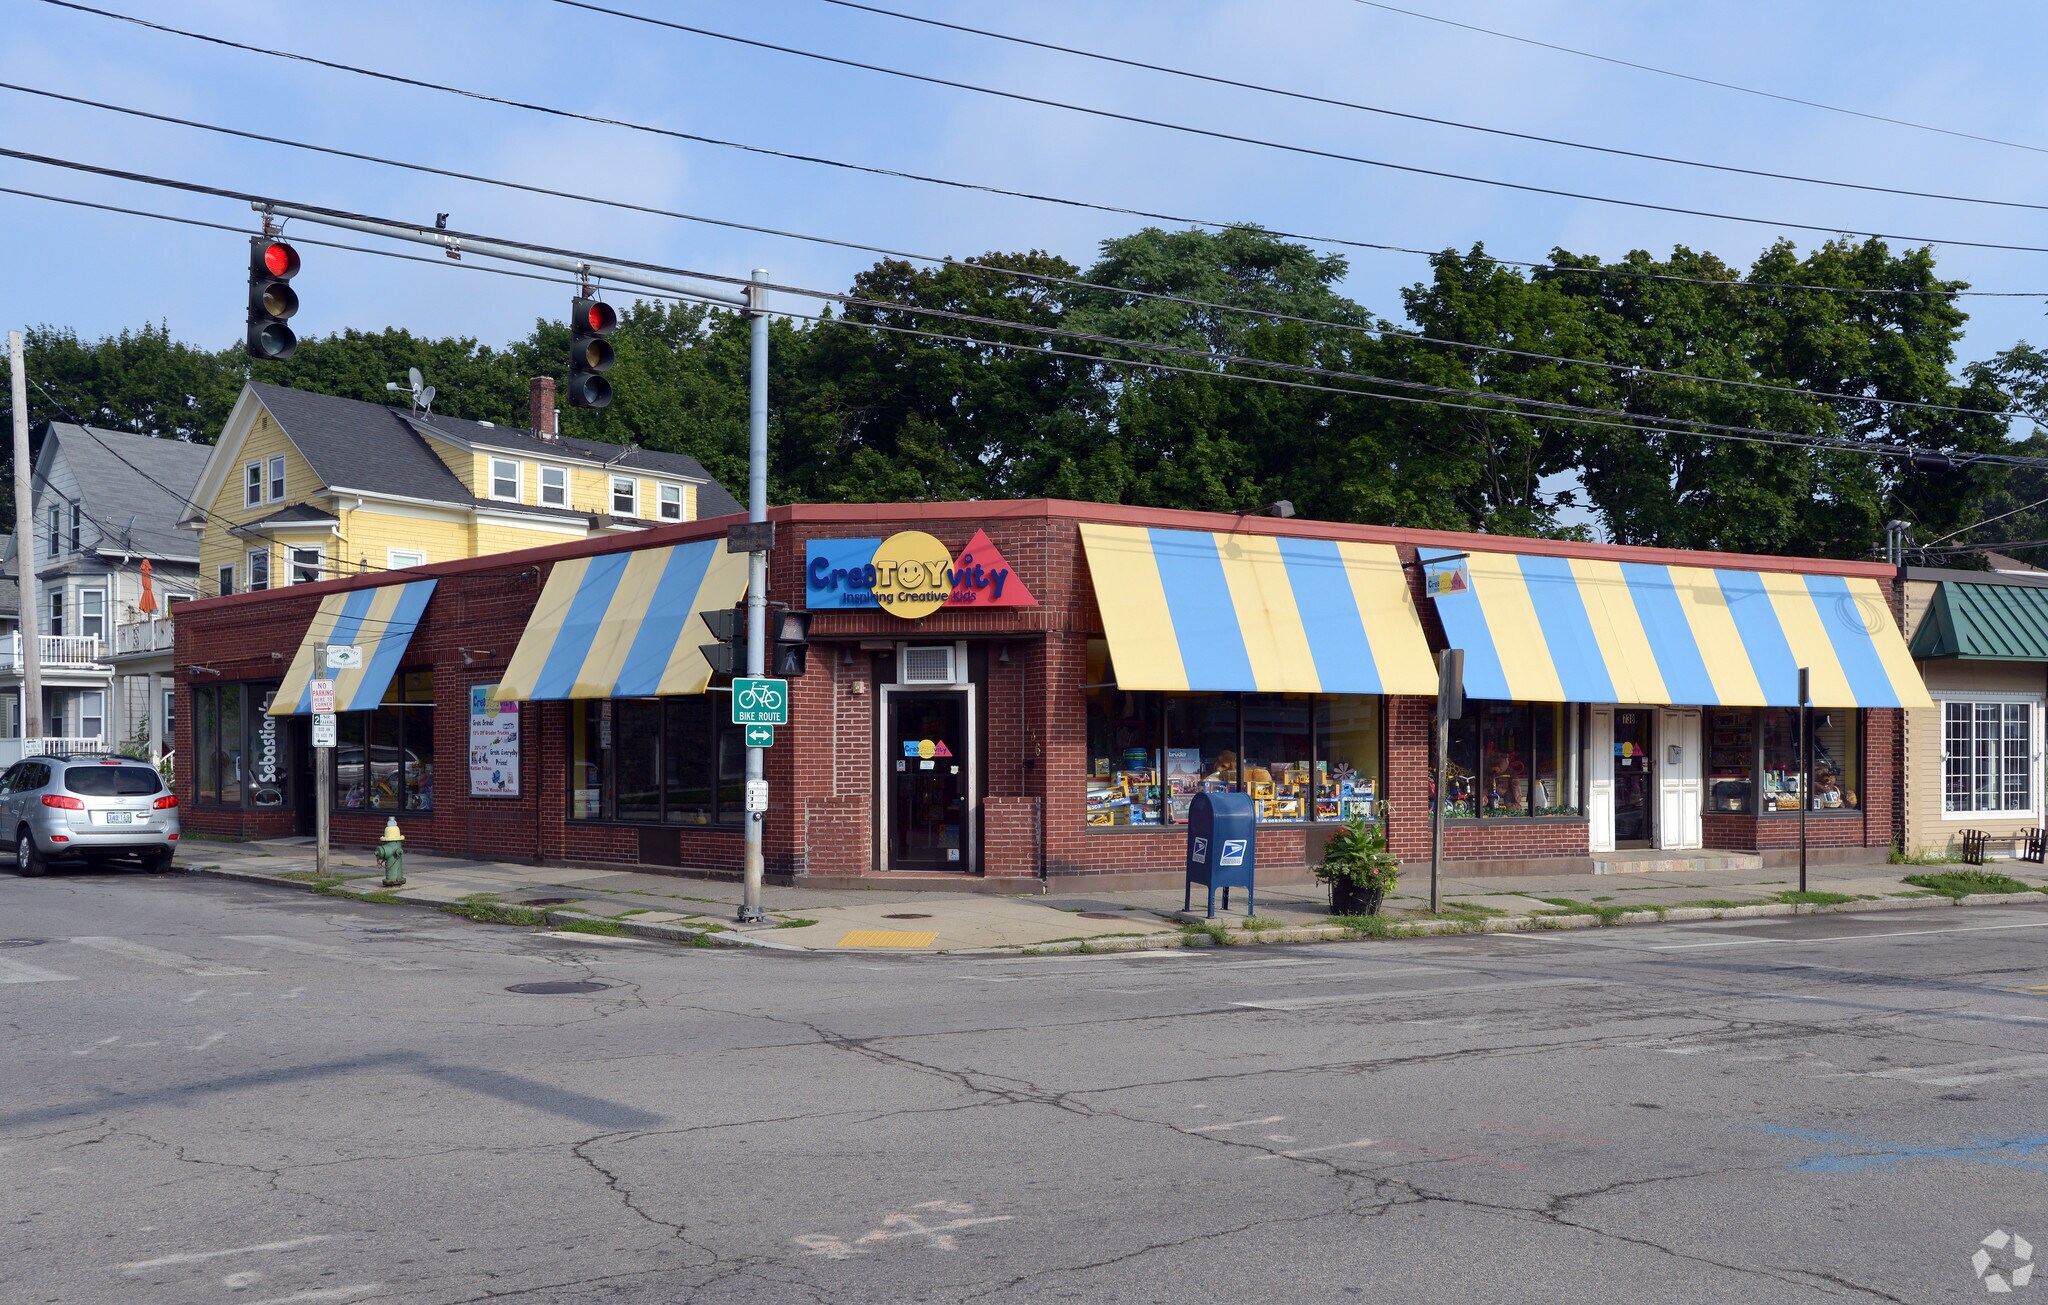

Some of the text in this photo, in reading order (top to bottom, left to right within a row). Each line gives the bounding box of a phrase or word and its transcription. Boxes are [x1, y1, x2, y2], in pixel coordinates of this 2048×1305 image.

[843, 591, 977, 604] Inspiring Creative Kids
[314, 716, 320, 724] 2
[739, 711, 781, 721] BIKE ROUTE
